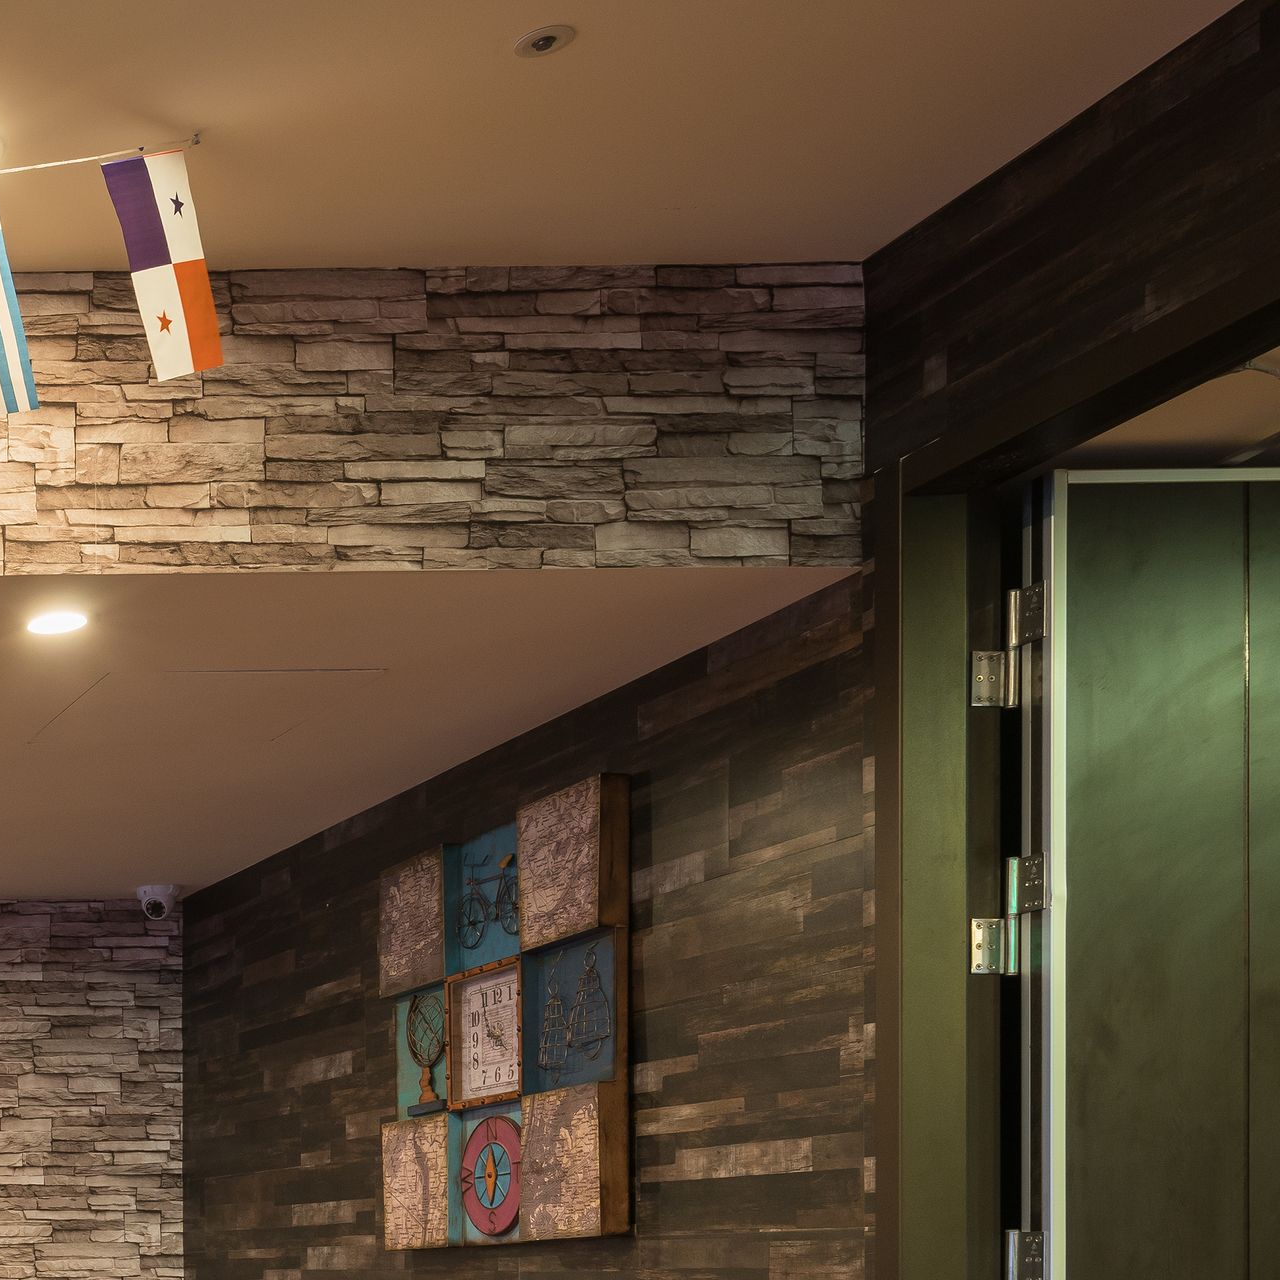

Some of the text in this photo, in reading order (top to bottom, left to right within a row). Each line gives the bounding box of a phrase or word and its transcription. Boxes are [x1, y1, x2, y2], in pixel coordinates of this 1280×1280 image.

[492, 987, 502, 1005] 12
[507, 984, 513, 1001] 1
[471, 1010, 480, 1028] 10
[472, 1032, 479, 1050] 9
[472, 1052, 479, 1071] 8
[481, 1068, 488, 1086] 7
[494, 1066, 501, 1083] 6
[507, 1063, 514, 1080] 5
[486, 1119, 497, 1141] N
[488, 1210, 497, 1233] S
